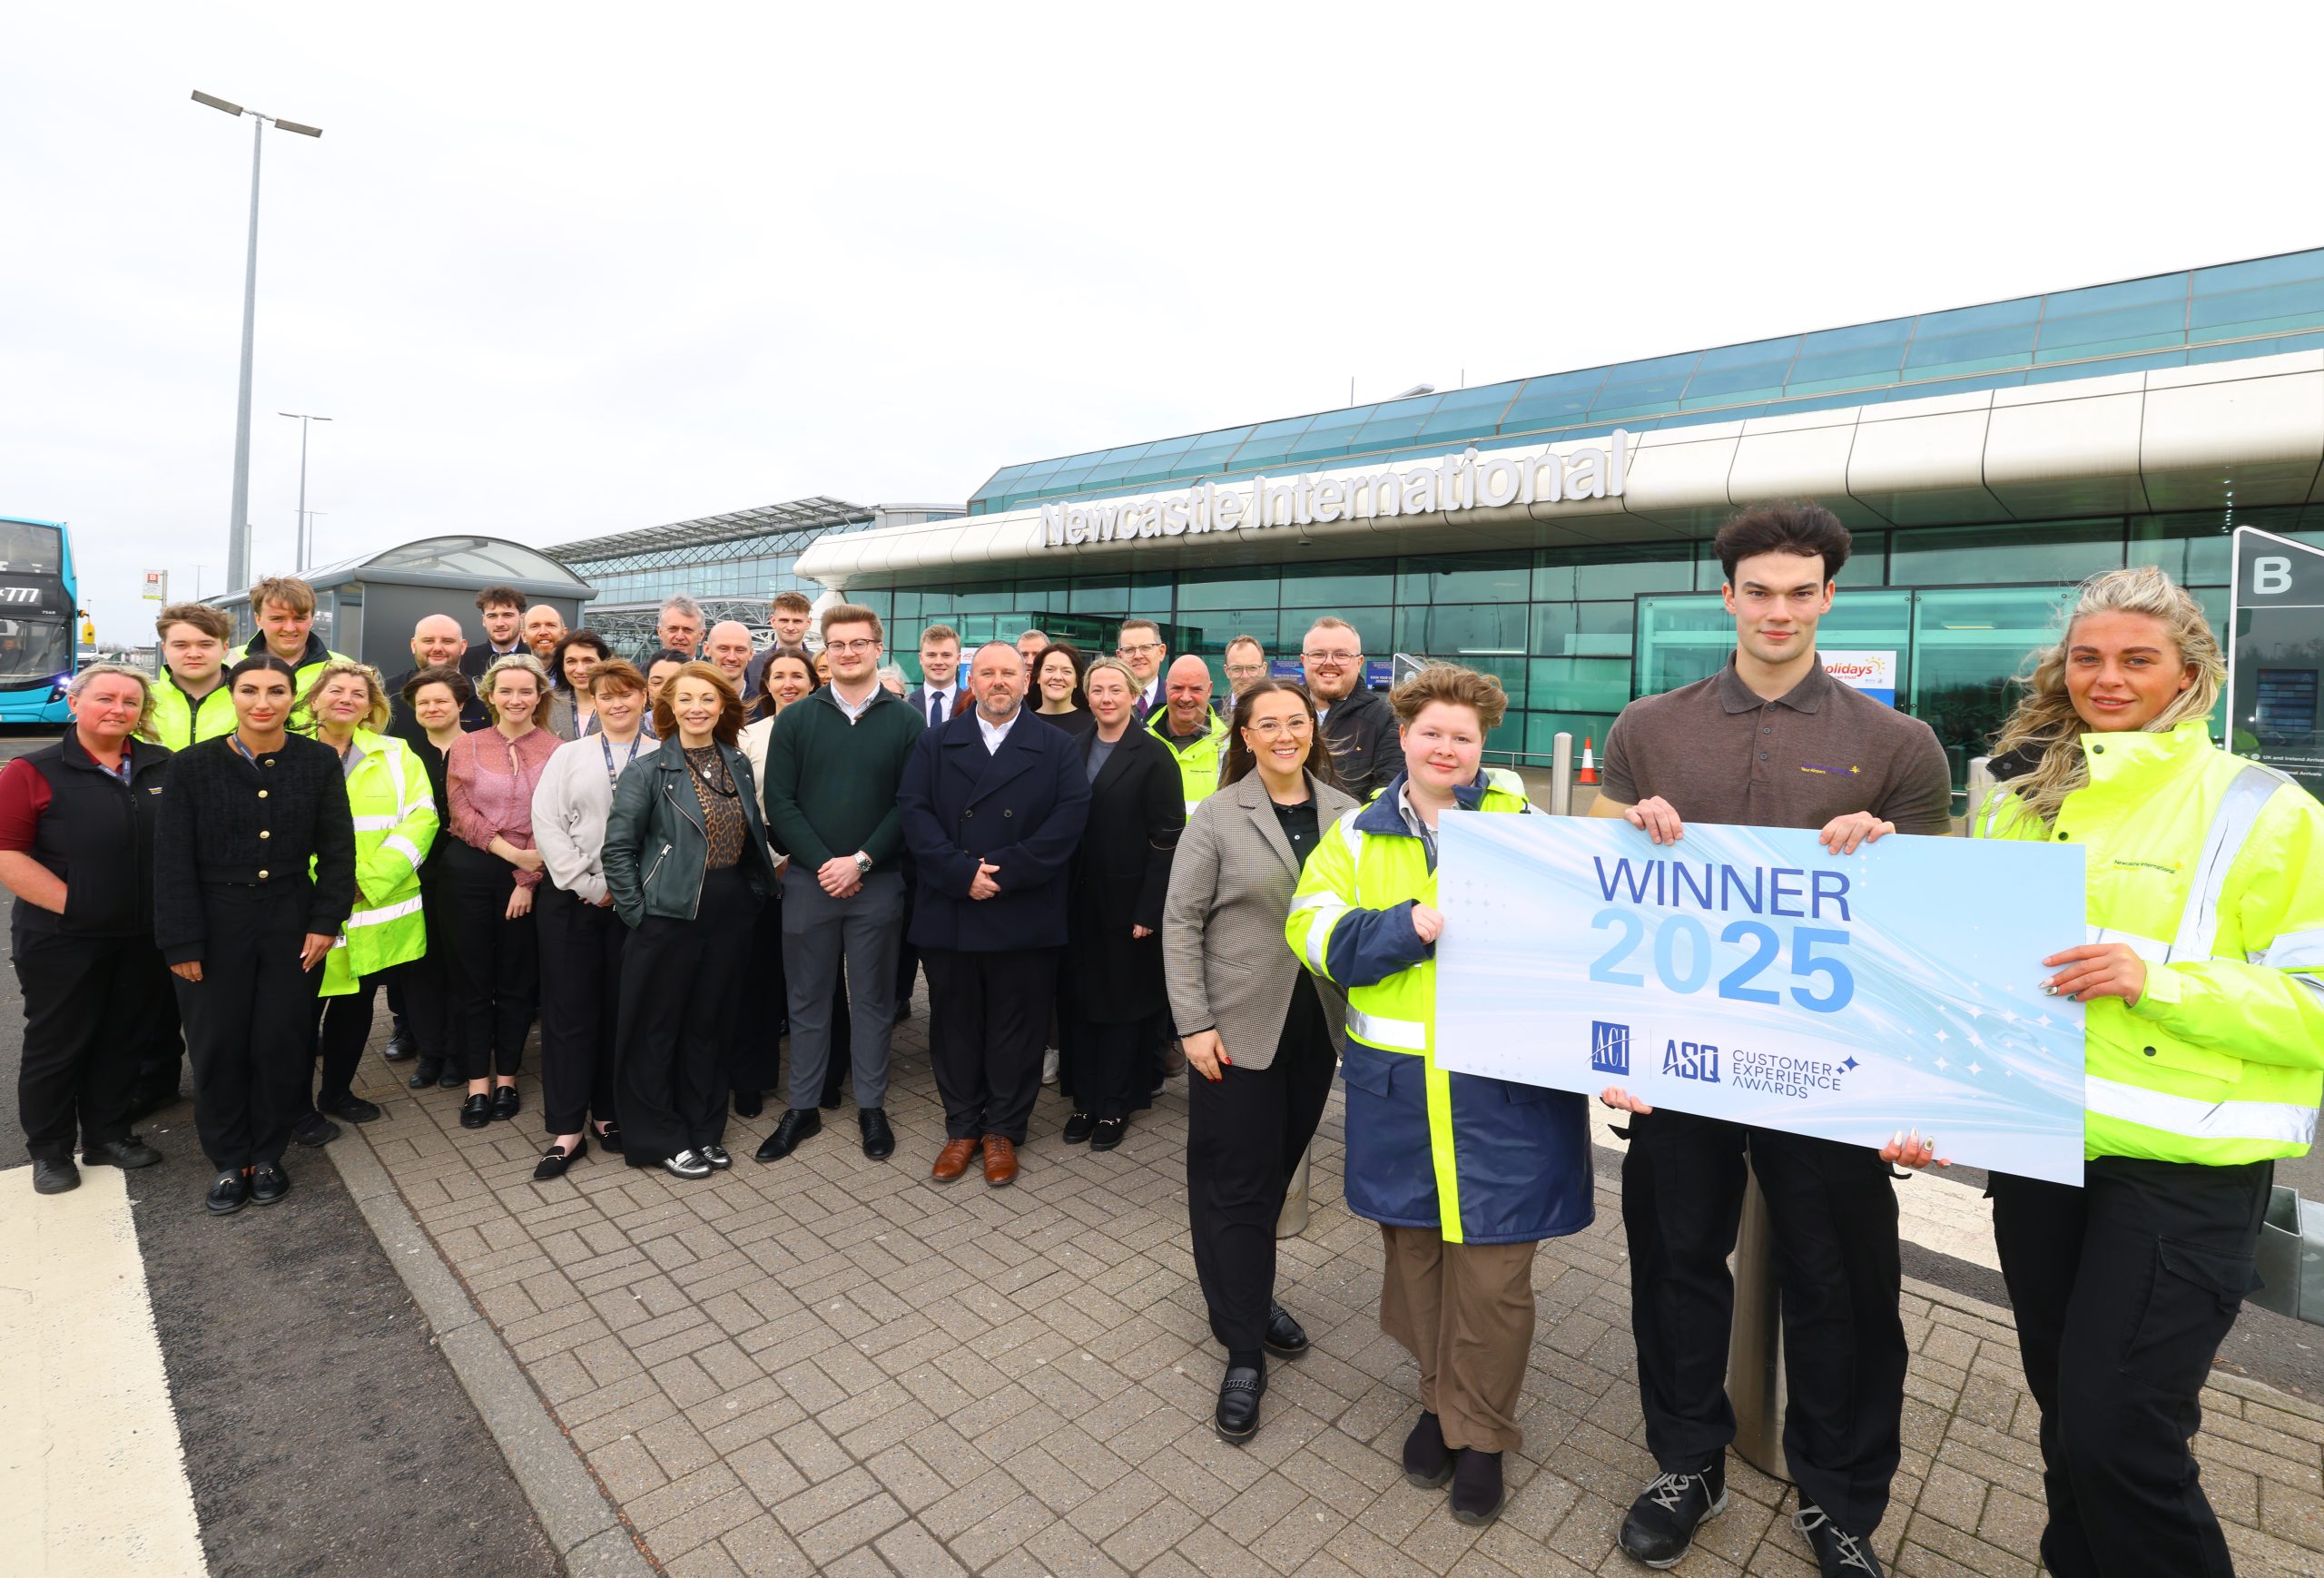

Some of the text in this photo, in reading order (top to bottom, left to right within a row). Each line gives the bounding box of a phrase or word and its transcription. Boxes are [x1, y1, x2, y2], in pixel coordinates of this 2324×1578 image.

[1040, 428, 1629, 547] Newcastle International
[2253, 556, 2293, 595] B
[1822, 662, 1874, 677] olidays
[1593, 855, 1852, 922] WINNER
[1589, 907, 1855, 1013] 2025
[1593, 1024, 1628, 1069] ACI
[1662, 1039, 1720, 1083] ASQ
[1732, 1050, 1833, 1077] CUSTOMER
[1732, 1062, 1842, 1091] EXPERIENCE
[1732, 1075, 1808, 1100] AWARDS
